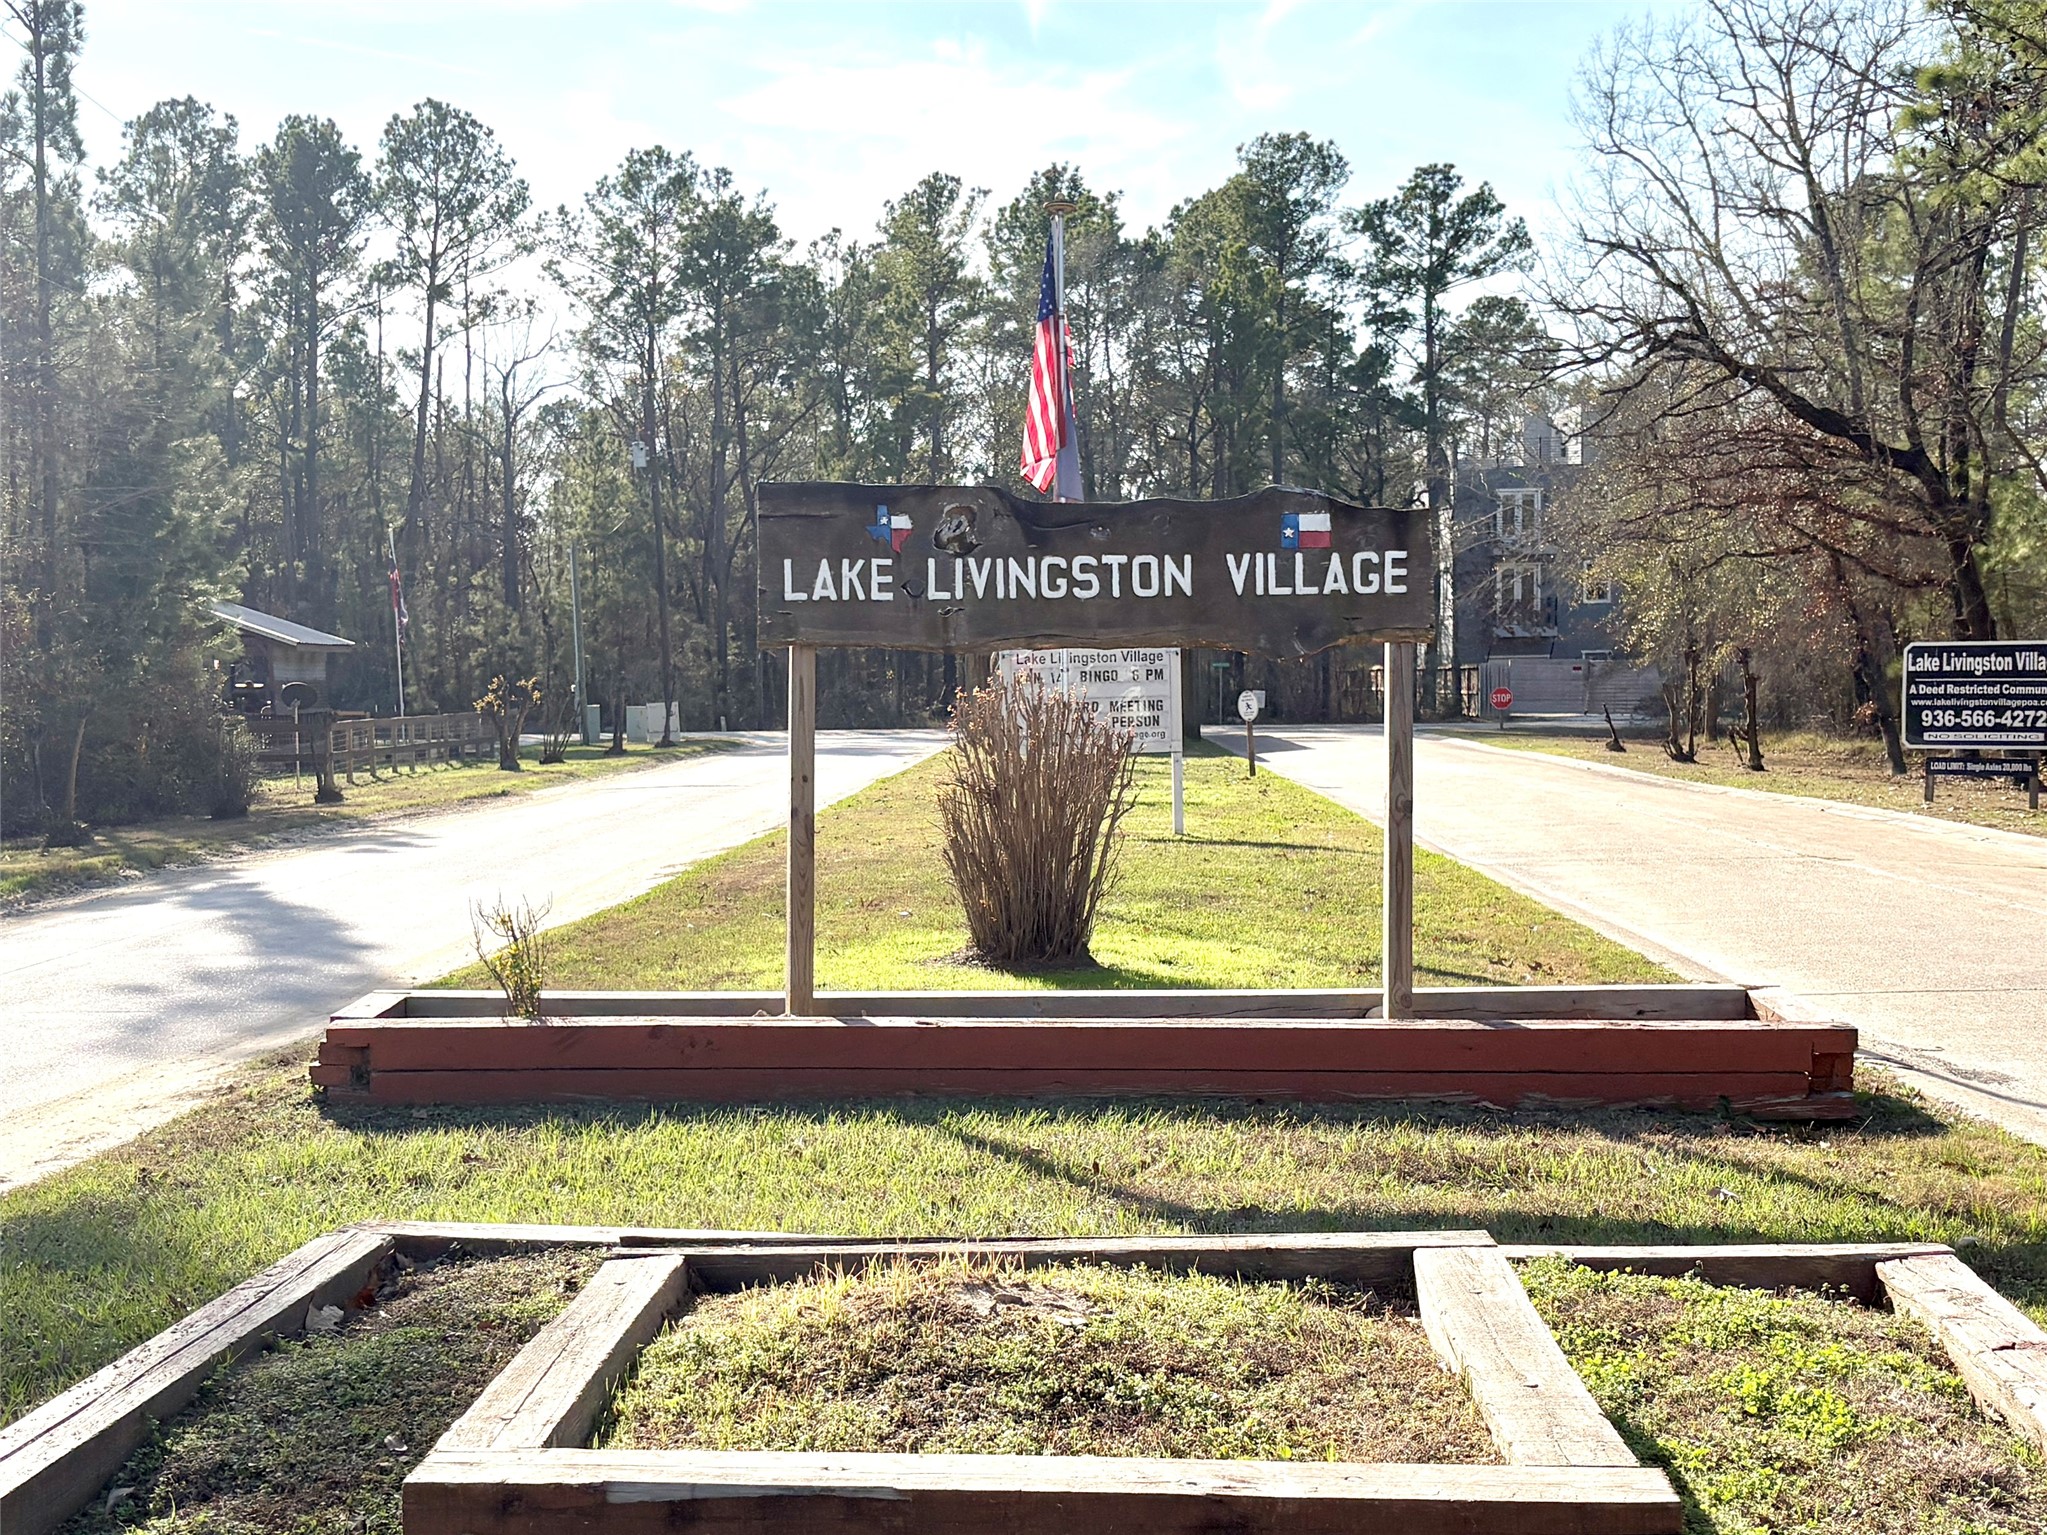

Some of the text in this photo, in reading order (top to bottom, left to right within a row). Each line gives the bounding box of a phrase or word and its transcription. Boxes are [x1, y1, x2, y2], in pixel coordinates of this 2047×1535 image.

[783, 549, 1408, 601] LAKE LIVINGSTON VILLAGE
[1016, 650, 1164, 666] Lake Liingston Village
[1907, 651, 2047, 676] Lake Livingston Villa
[1080, 670, 1119, 683] BINGO
[1131, 669, 1140, 682] 6
[1145, 668, 1164, 681] PM
[1909, 684, 1917, 694] A
[1919, 684, 1945, 694] Deed
[1946, 683, 2001, 695] Restricted
[1492, 693, 1511, 703] STOP
[1911, 698, 2047, 708] www.lakelivingstonvillagepoa.c
[1109, 699, 1164, 712] MEETING
[1111, 714, 1160, 728] PERSON
[1921, 709, 2047, 728] 936-566-4272
[1930, 762, 1947, 771] LOAD
[1966, 762, 1985, 773] Single
[2023, 763, 2034, 772] lbs
